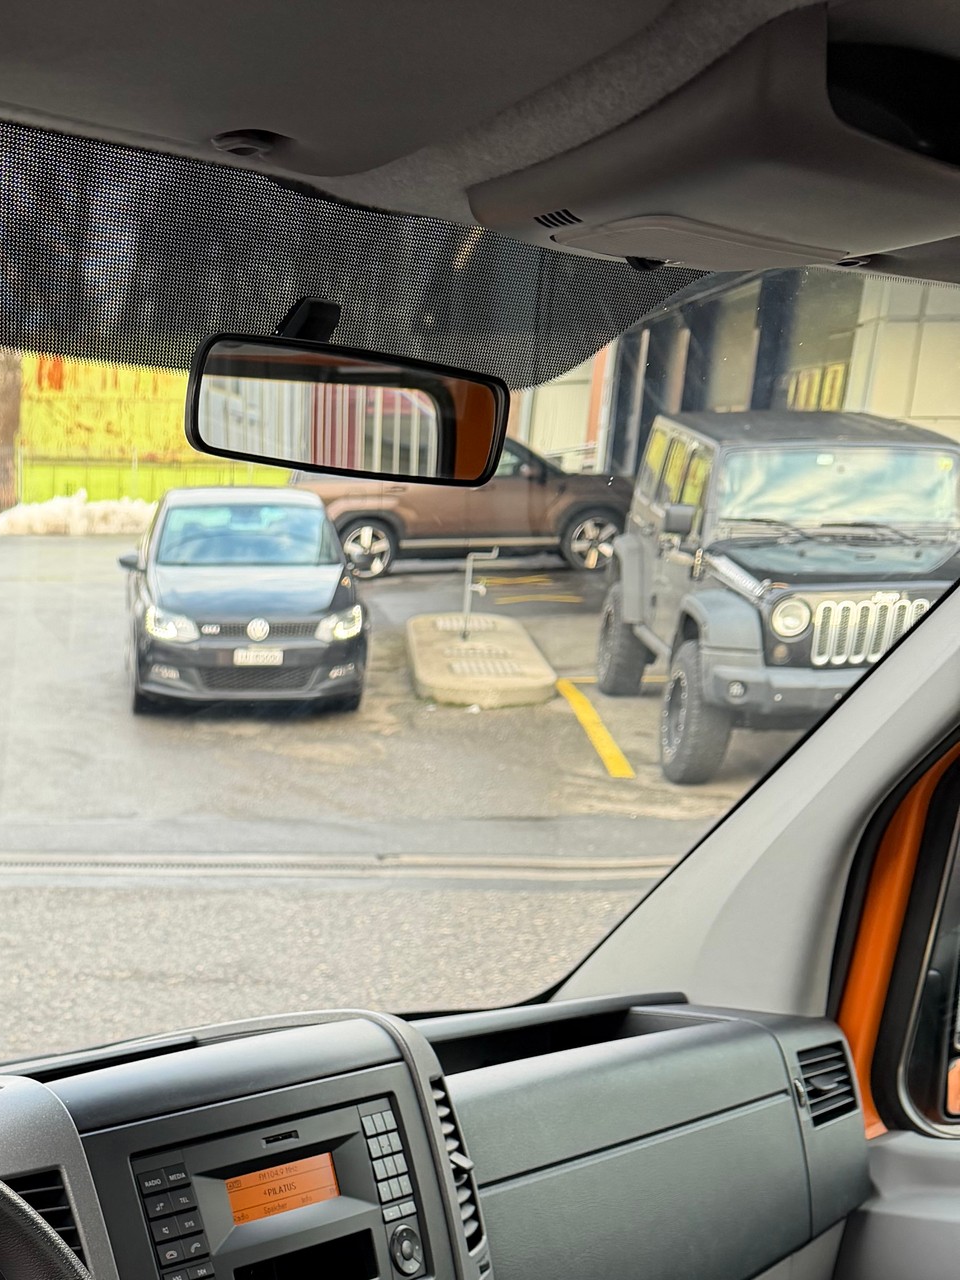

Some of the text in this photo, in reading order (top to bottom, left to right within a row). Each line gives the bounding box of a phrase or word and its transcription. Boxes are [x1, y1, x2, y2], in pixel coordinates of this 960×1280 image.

[169, 1172, 186, 1181] MEDIA
[144, 1178, 161, 1187] RADIO
[267, 1182, 296, 1196] PILATUS
